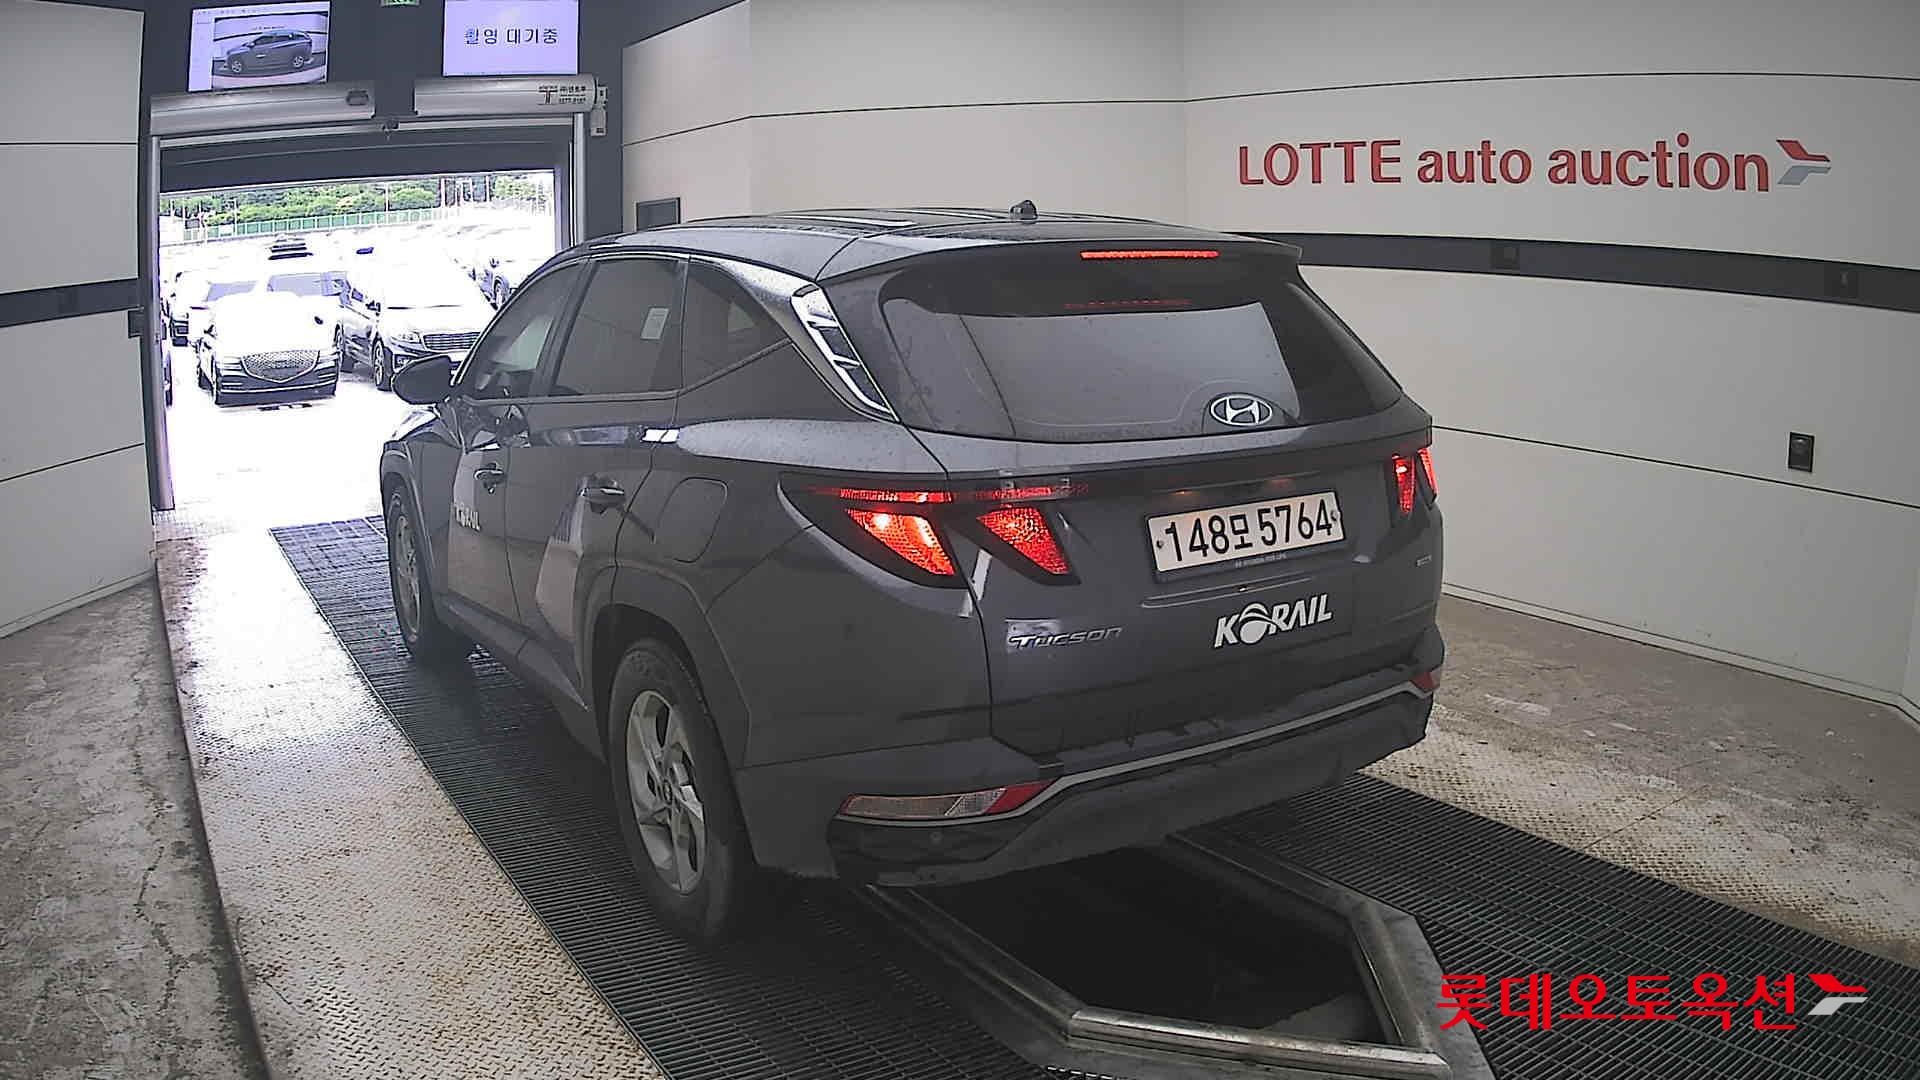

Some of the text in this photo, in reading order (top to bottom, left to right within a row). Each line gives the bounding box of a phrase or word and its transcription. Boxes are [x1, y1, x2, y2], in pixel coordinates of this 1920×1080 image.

[506, 28, 558, 45] 대기중
[1238, 132, 1770, 191] LOTTE auto auction
[1164, 499, 1333, 562] 148모 5764
[1213, 593, 1333, 649] KORAIL
